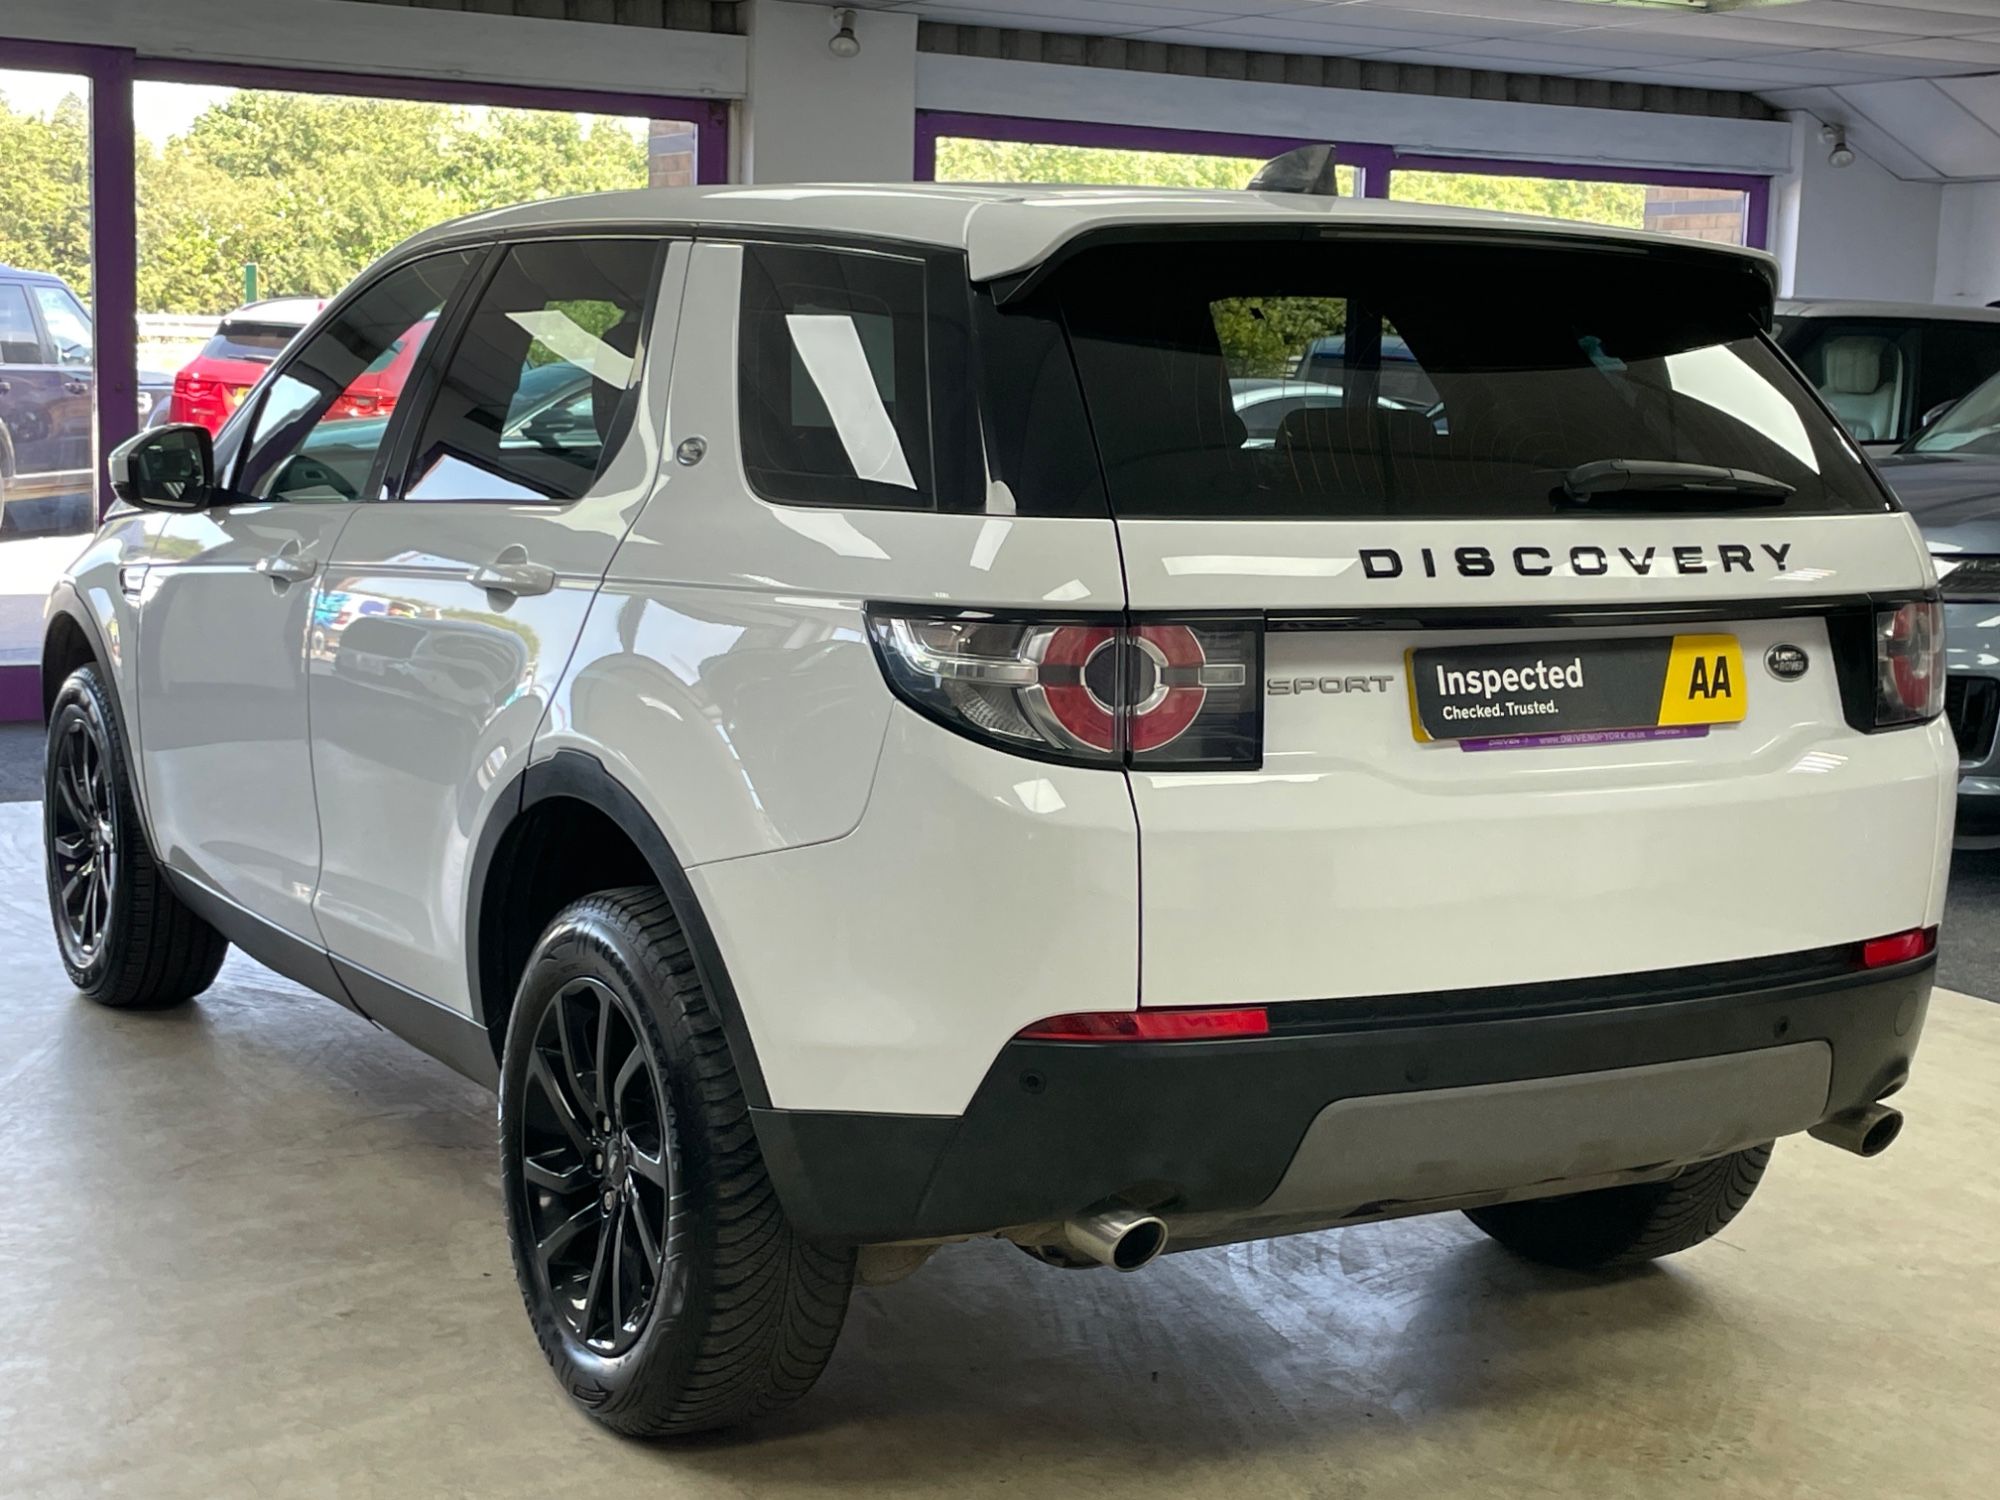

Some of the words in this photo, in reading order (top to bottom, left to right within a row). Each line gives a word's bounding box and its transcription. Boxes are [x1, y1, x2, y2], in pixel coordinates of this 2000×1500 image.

[1359, 543, 1791, 579] DISCOVERY
[1267, 675, 1394, 695] SPORT
[1436, 657, 1584, 699] Inspected
[1688, 655, 1732, 700] AA
[1443, 703, 1504, 721] Checked.
[1506, 699, 1559, 717] Trusted.
